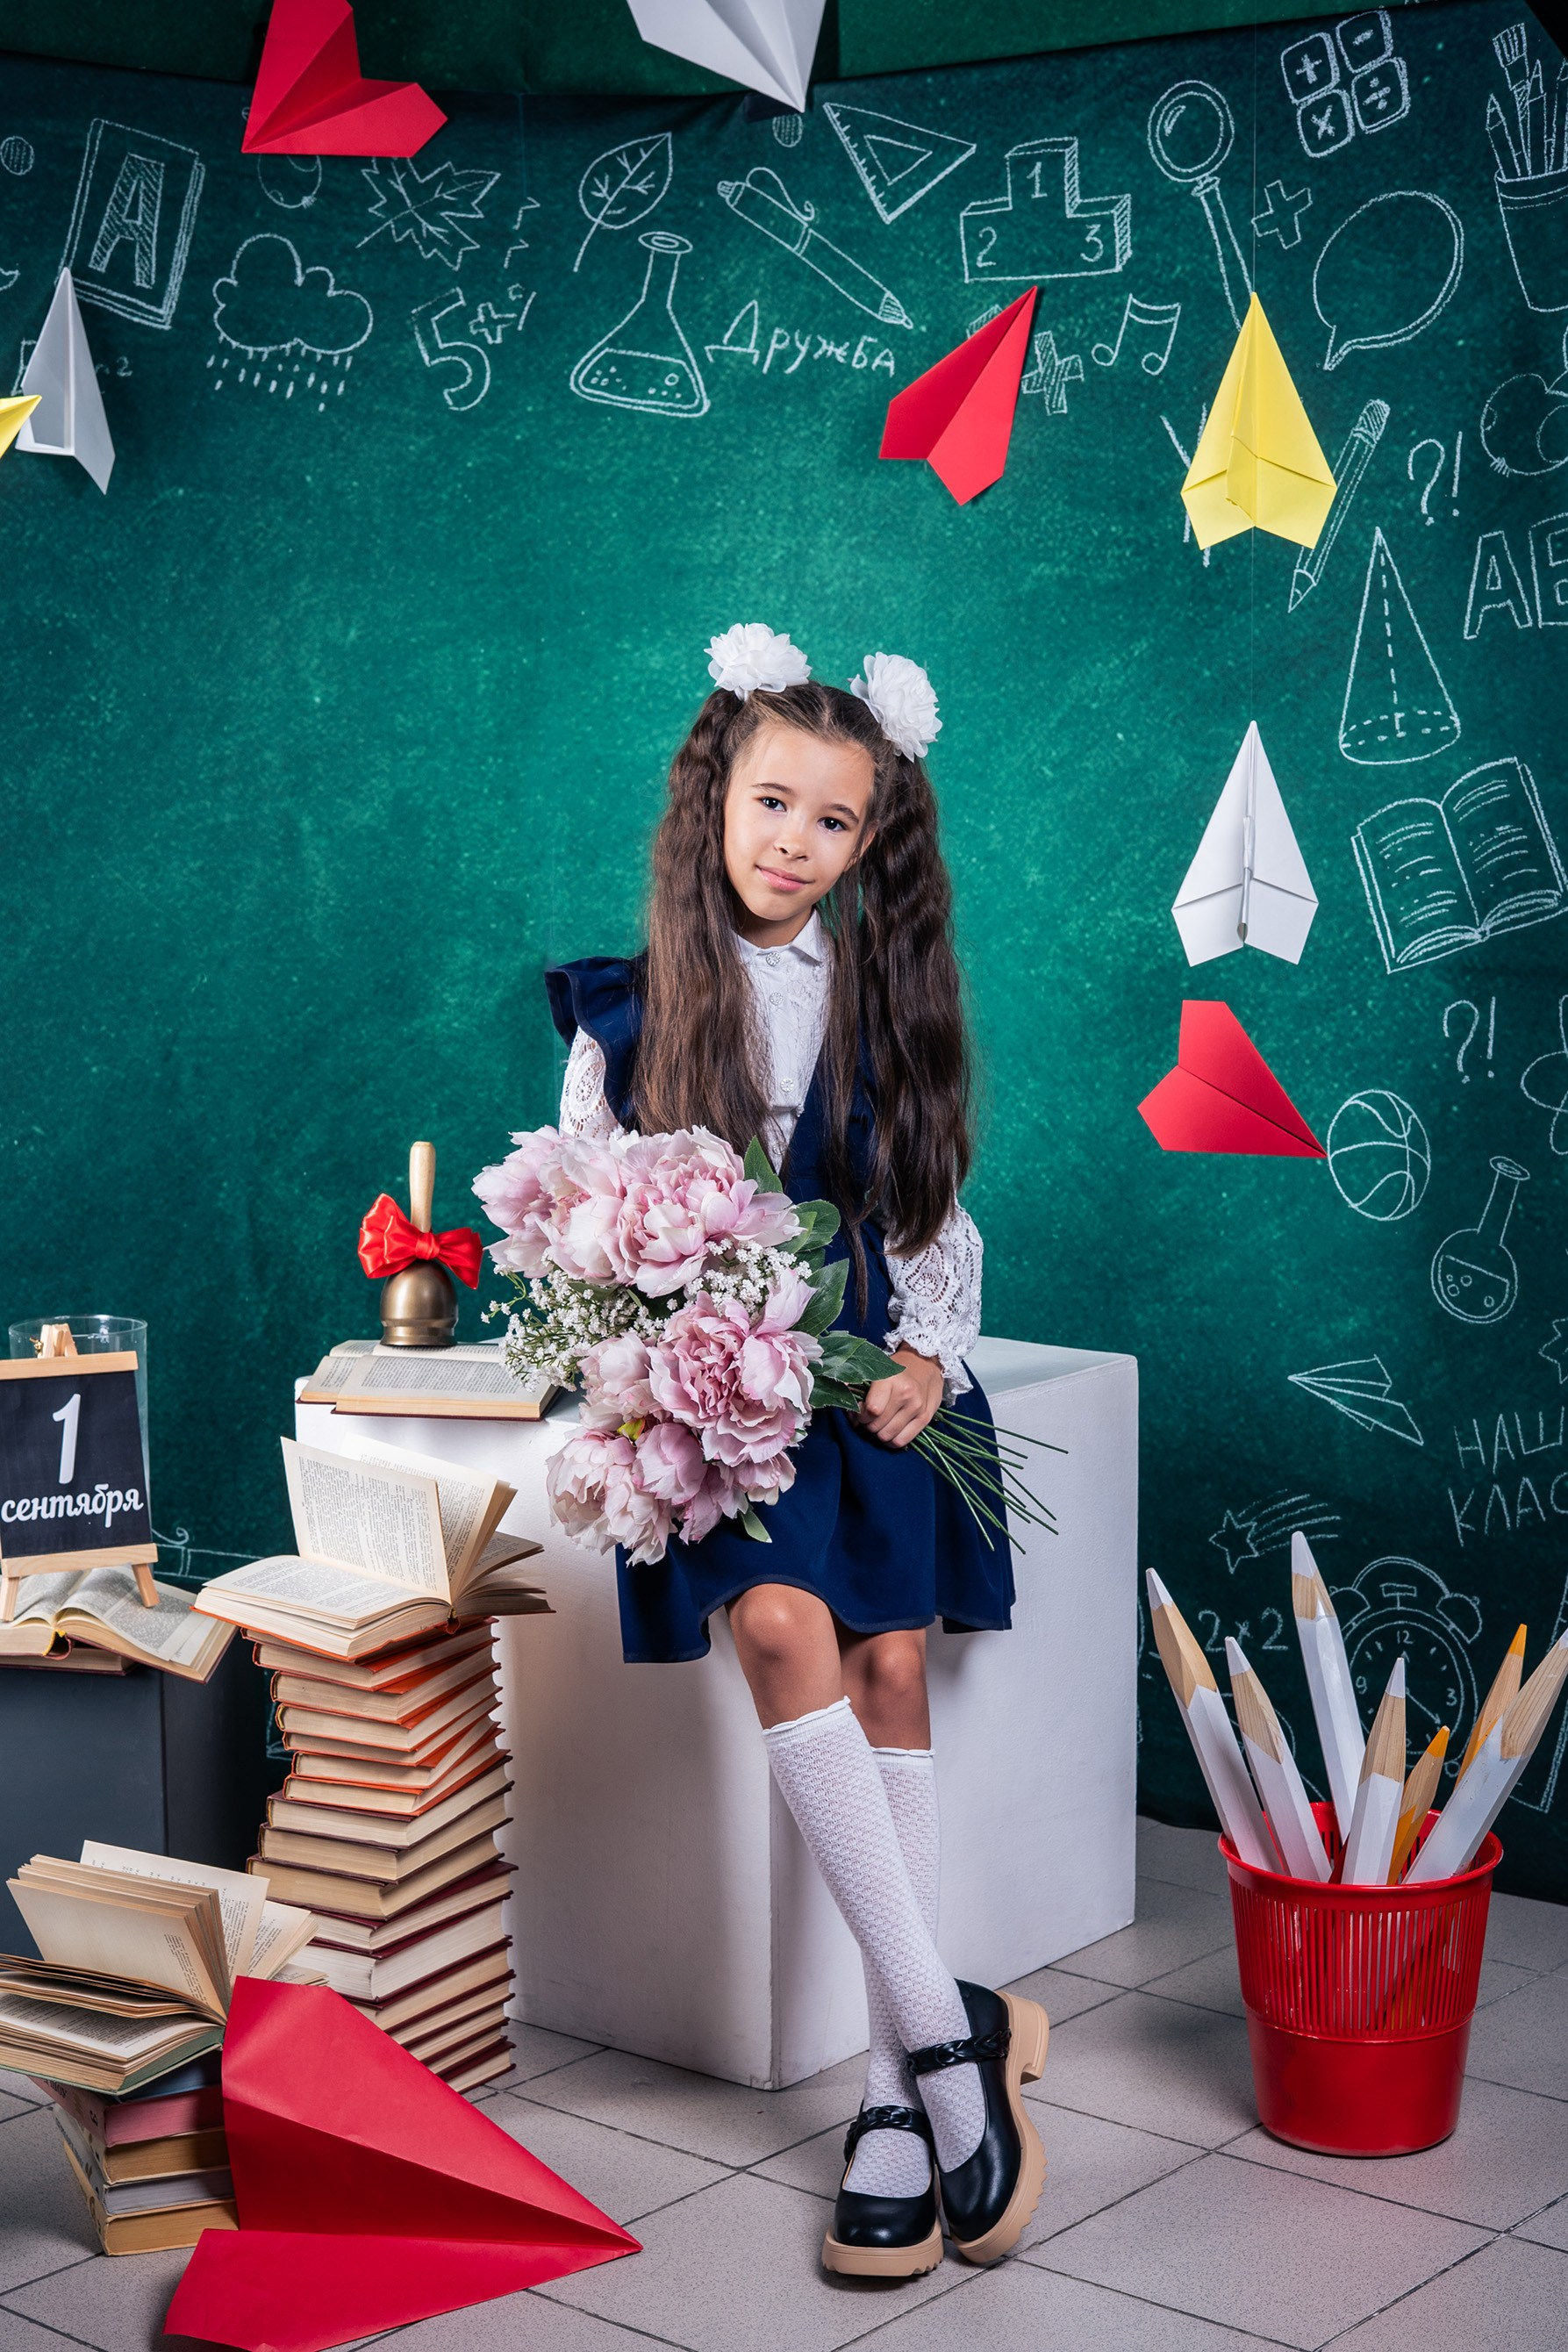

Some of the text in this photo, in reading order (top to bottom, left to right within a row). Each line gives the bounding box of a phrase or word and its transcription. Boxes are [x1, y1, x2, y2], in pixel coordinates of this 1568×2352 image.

[1027, 161, 1048, 199] 1
[977, 224, 1104, 268] 2 3
[52, 1393, 82, 1484] 1
[1453, 1406, 1565, 1474] НАШ
[1, 1483, 144, 1528] сентября
[1396, 1630, 1414, 1644] 12
[1445, 1687, 1457, 1706] 3
